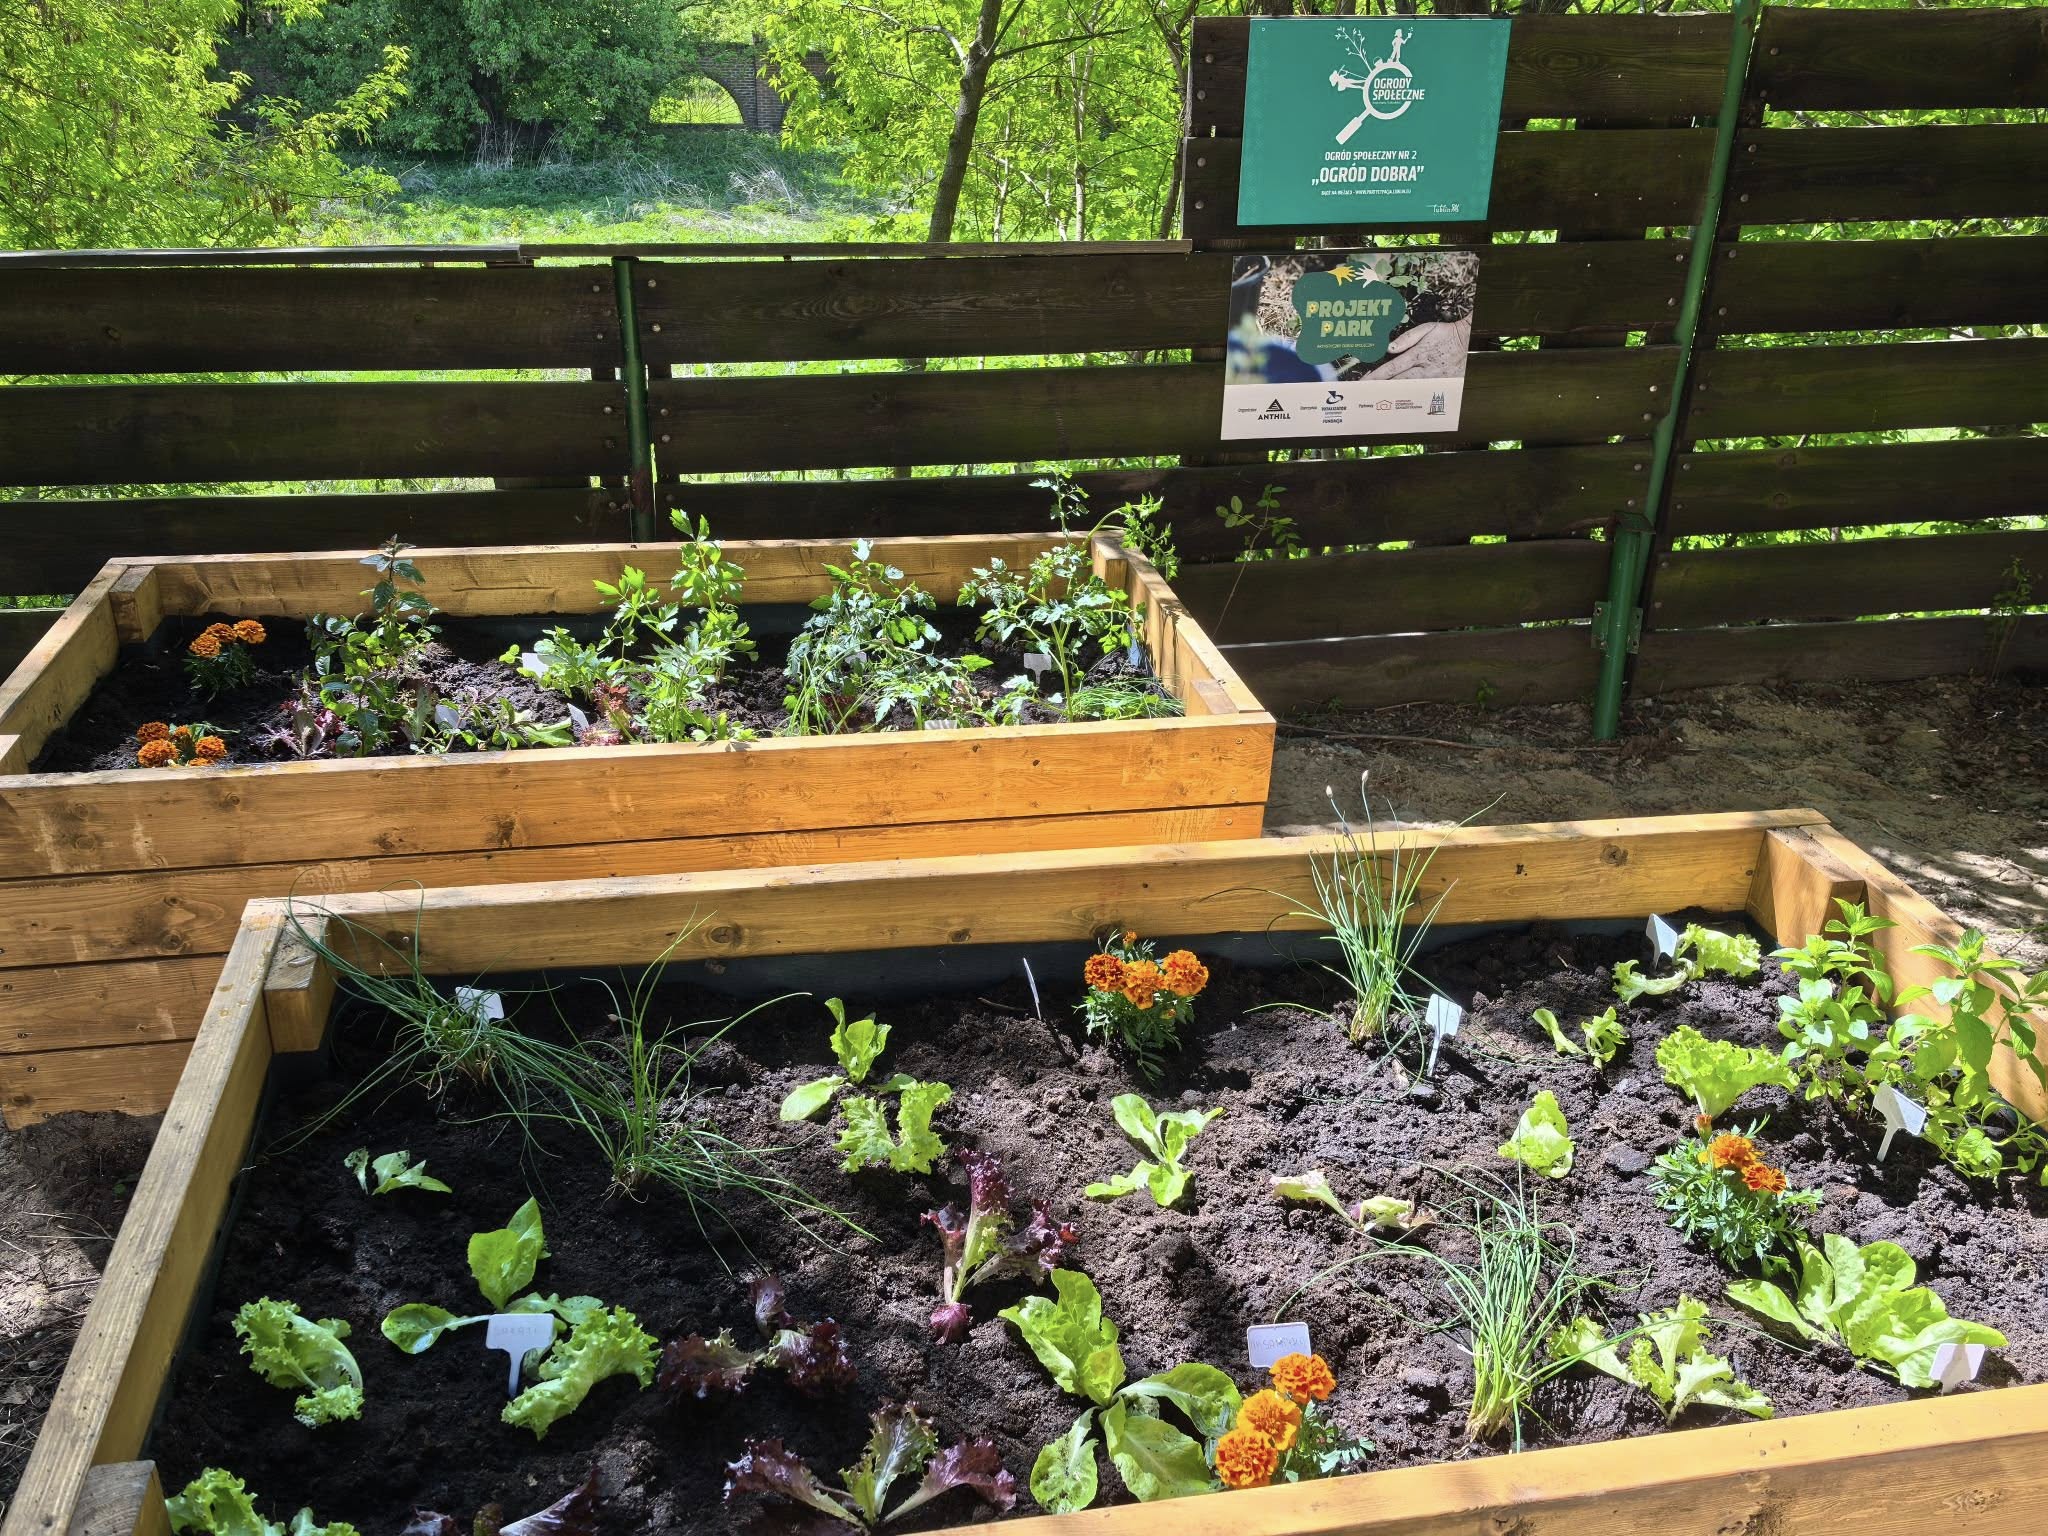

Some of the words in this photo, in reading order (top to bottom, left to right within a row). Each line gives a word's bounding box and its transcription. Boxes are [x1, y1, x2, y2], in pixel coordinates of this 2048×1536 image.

[1373, 77, 1412, 89] OGRODY
[1372, 89, 1426, 101] SPOŁECZNE
[1324, 149, 1351, 161] OGRÓD
[1353, 150, 1397, 161] SPOŁECZNY
[1398, 150, 1410, 160] NR
[1411, 150, 1417, 160] 2
[1311, 162, 1367, 186] „OGRÓD
[1305, 298, 1393, 318] PROJEKT
[1320, 319, 1374, 338] PARK
[1257, 413, 1291, 421] ANTHILL
